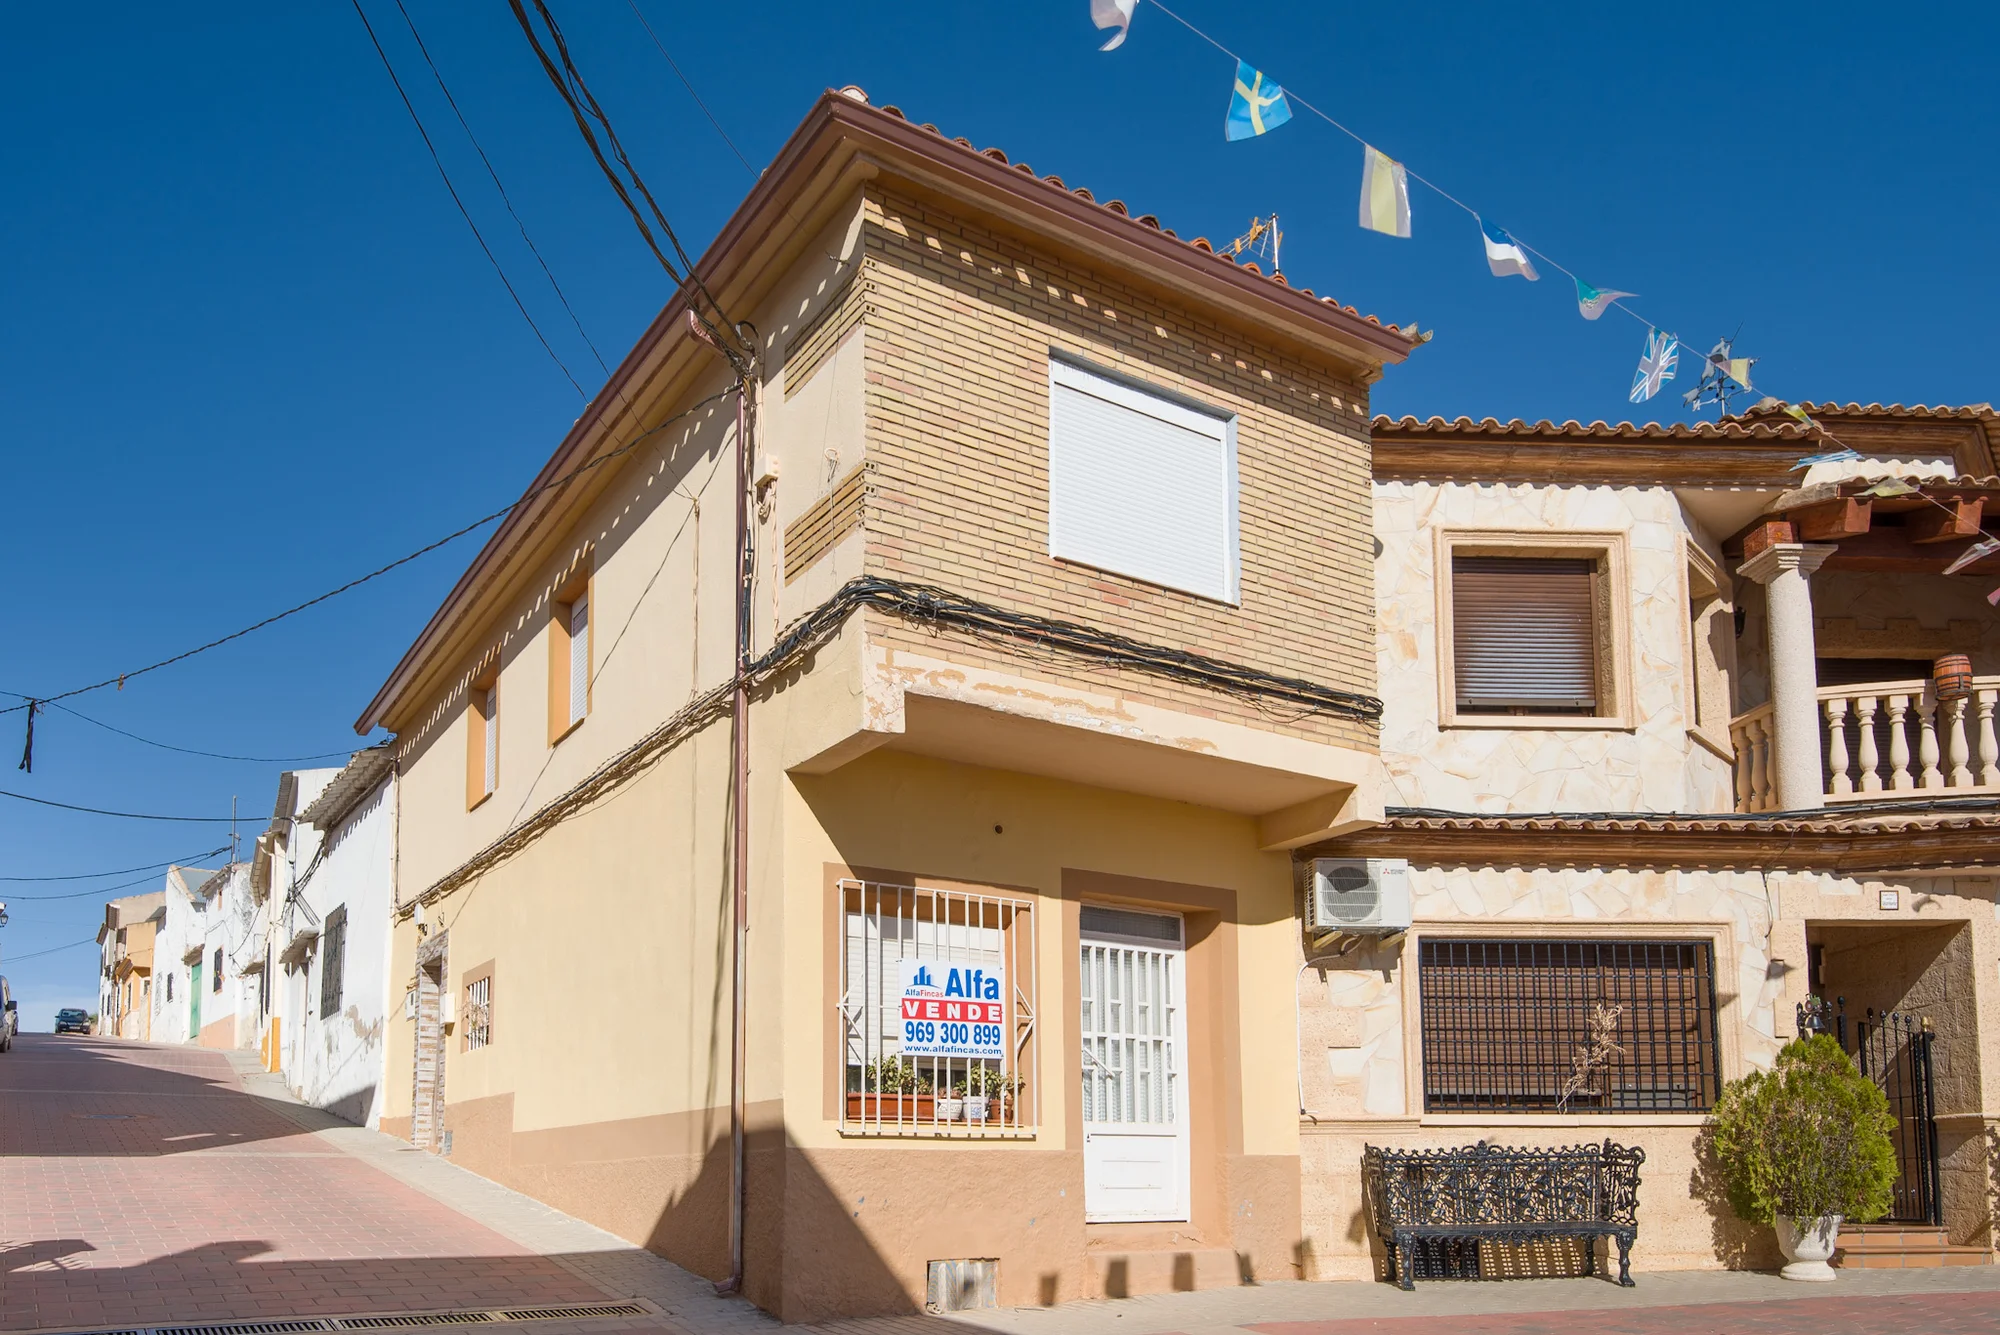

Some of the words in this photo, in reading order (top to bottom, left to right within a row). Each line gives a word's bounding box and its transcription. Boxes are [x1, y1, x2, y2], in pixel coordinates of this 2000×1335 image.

[905, 988, 944, 998] AlfaFincas
[945, 968, 999, 1000] Alfa
[904, 1001, 1001, 1021] VENDE
[905, 1021, 935, 1043] 969
[940, 1022, 968, 1044] 300
[973, 1024, 1001, 1046] 899
[905, 1045, 1002, 1055] www.alfafincas.com
